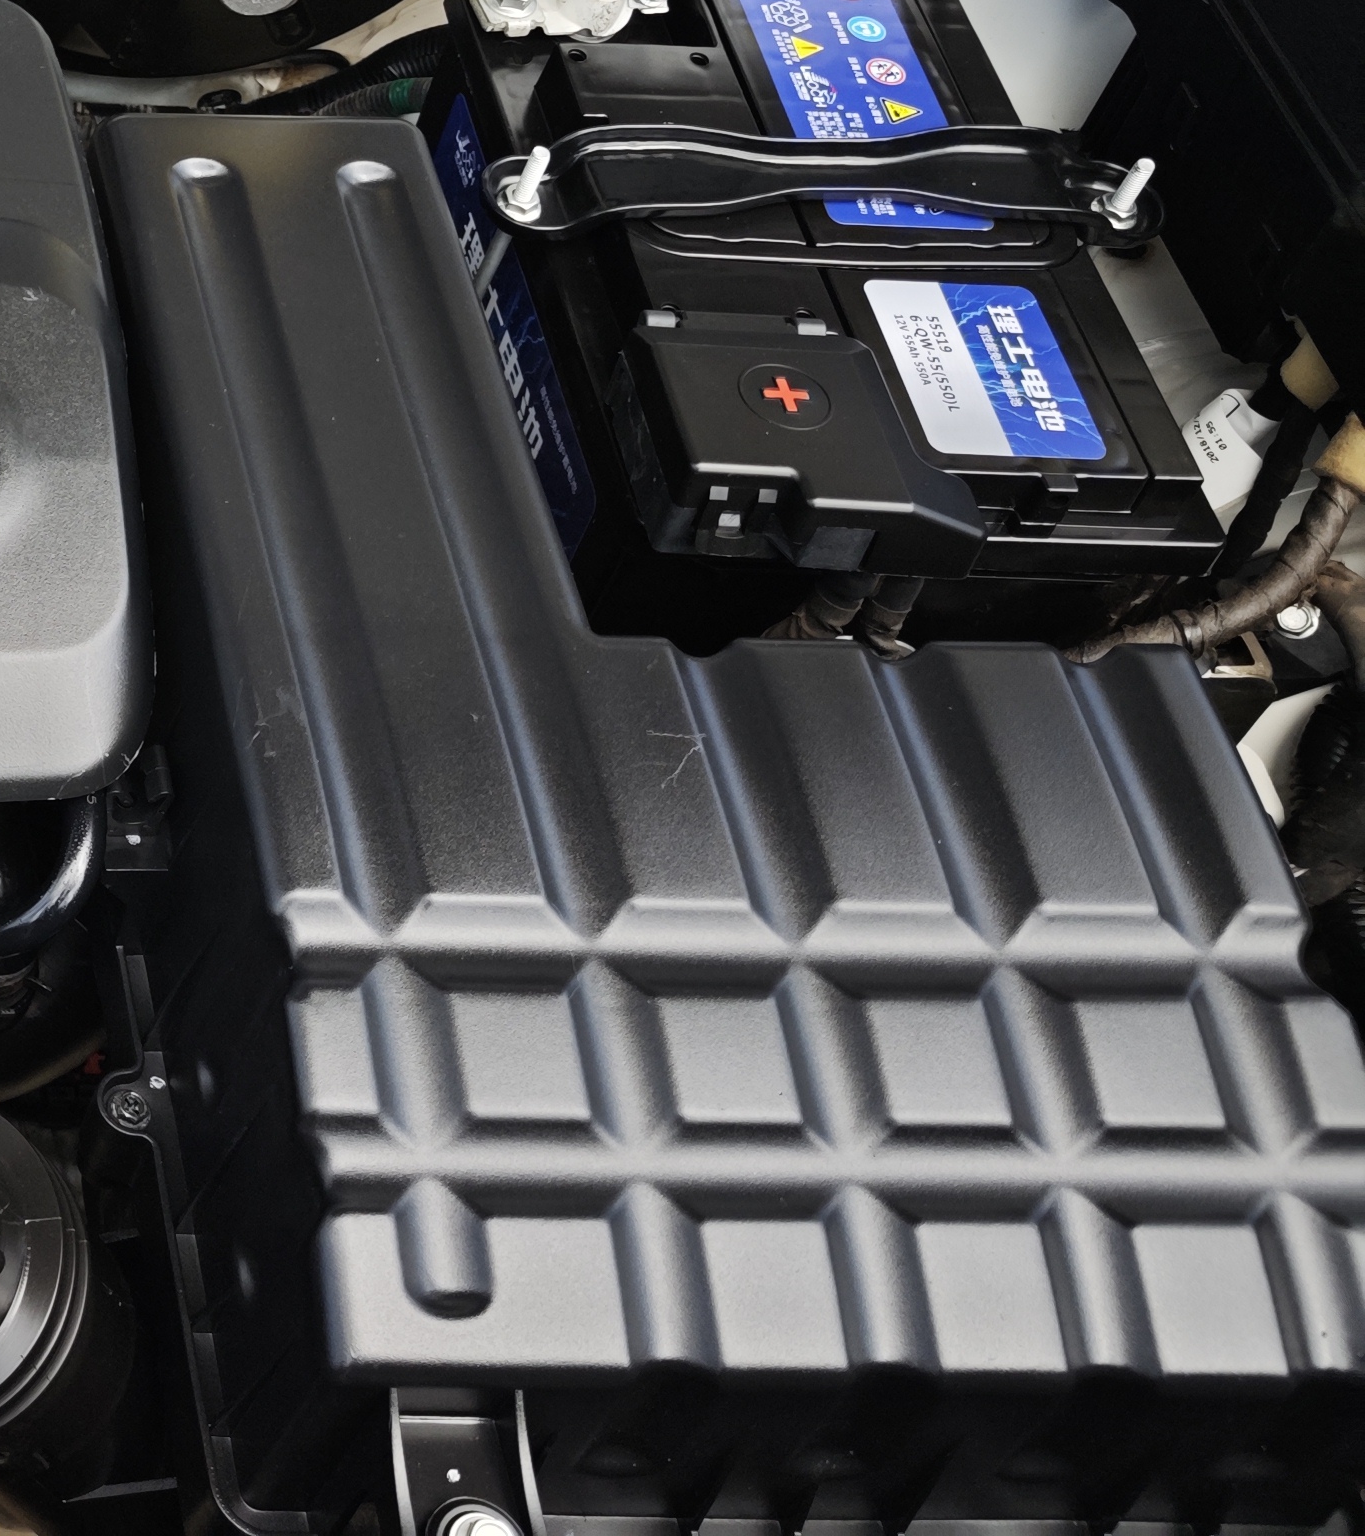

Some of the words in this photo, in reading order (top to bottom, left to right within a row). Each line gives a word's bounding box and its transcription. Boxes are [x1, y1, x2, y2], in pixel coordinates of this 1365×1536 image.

[894, 313, 909, 332] 12V
[902, 334, 921, 359] 55Ah
[914, 361, 932, 386] 550A
[909, 314, 961, 413] 6-QW-55(550)L
[926, 315, 953, 354] 55519
[986, 303, 1067, 432] 理士电池
[1205, 420, 1228, 451] 01:55
